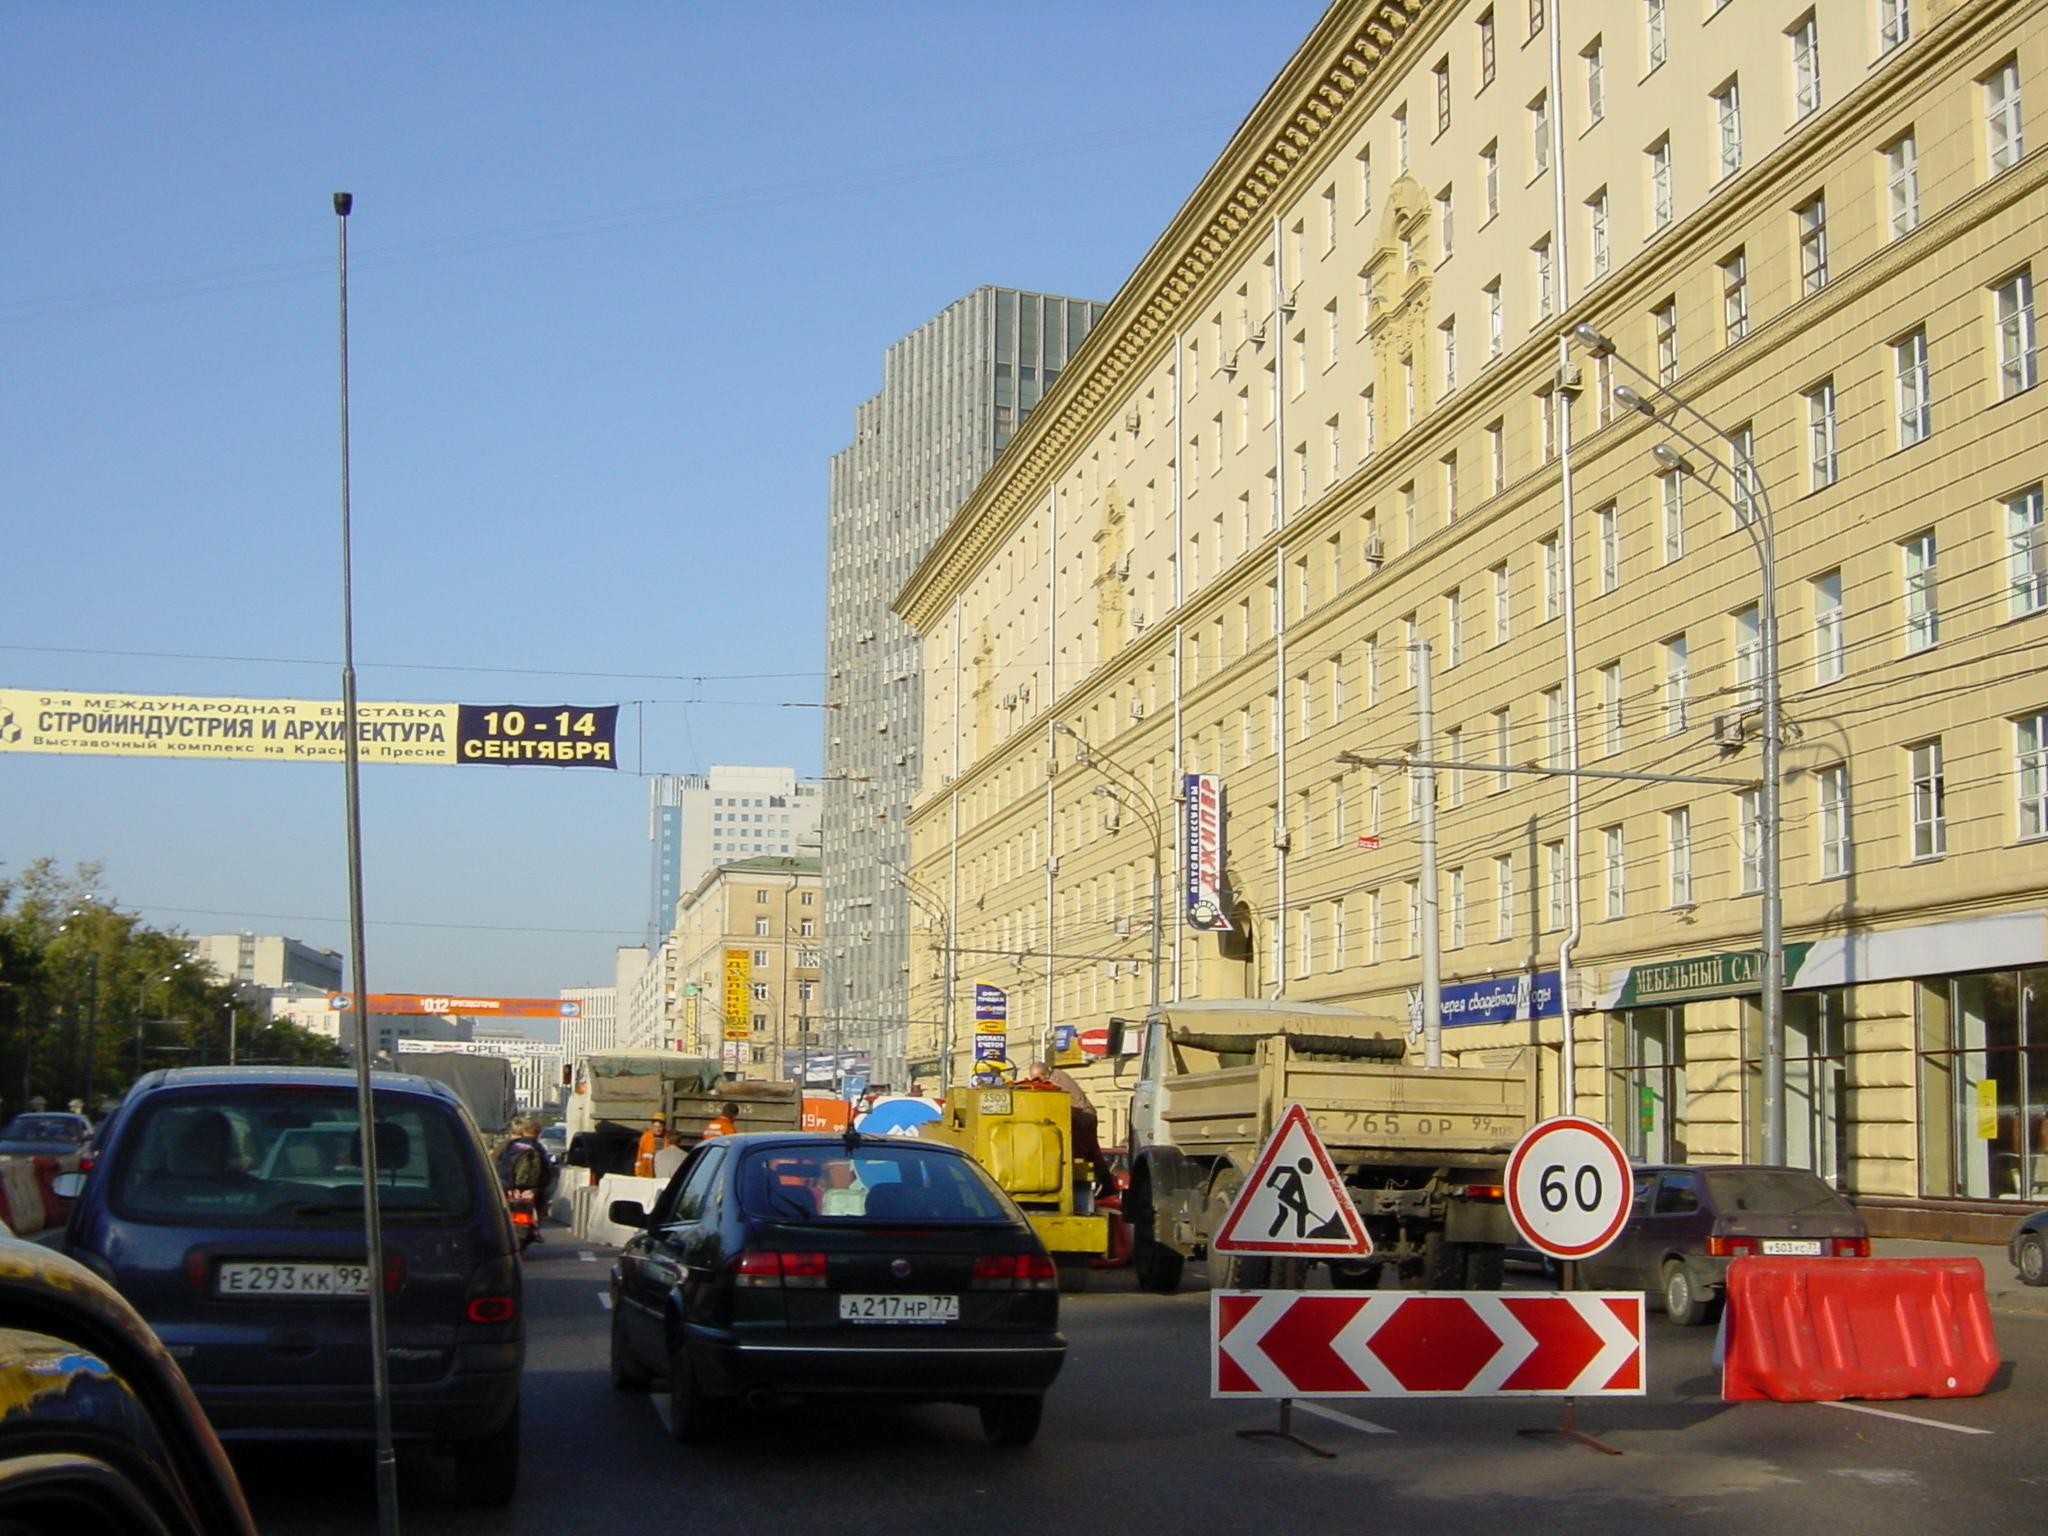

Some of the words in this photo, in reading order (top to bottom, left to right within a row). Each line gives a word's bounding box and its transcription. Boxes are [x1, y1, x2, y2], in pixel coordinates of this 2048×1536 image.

[39, 697, 73, 707] 9-я
[84, 698, 296, 715] МЕЖДУНАРОДНАЯ
[38, 709, 253, 739] СТРОЙИНДУСТРИЯ
[262, 719, 277, 739] И
[283, 720, 445, 743] АРХИЕКТУРА
[483, 711, 525, 736] 10
[555, 711, 596, 737] 14
[33, 736, 157, 750] Выставочный
[167, 742, 255, 754] комплекс
[264, 744, 286, 754] на
[294, 745, 371, 757] Краснй
[381, 746, 447, 758] Пресне
[464, 739, 611, 761] СЕНТЯБРЯ
[1189, 785, 1200, 894] АВТОАКСЕССУАРЫ
[1201, 778, 1217, 894] ДЖИПЕР
[1636, 956, 1723, 994] МЕБЕЛЬНЫЙ
[1731, 950, 1787, 983] САЛ
[1468, 985, 1517, 1016] свадебной
[466, 1044, 506, 1054] OPEL
[983, 1093, 1008, 1103] 3500
[1343, 1113, 1401, 1135] 765
[1471, 1116, 1493, 1132] 99
[1491, 1125, 1514, 1136] RUS
[1540, 1164, 1602, 1213] 60
[338, 1267, 363, 1286] 99
[933, 1296, 953, 1312] 77
